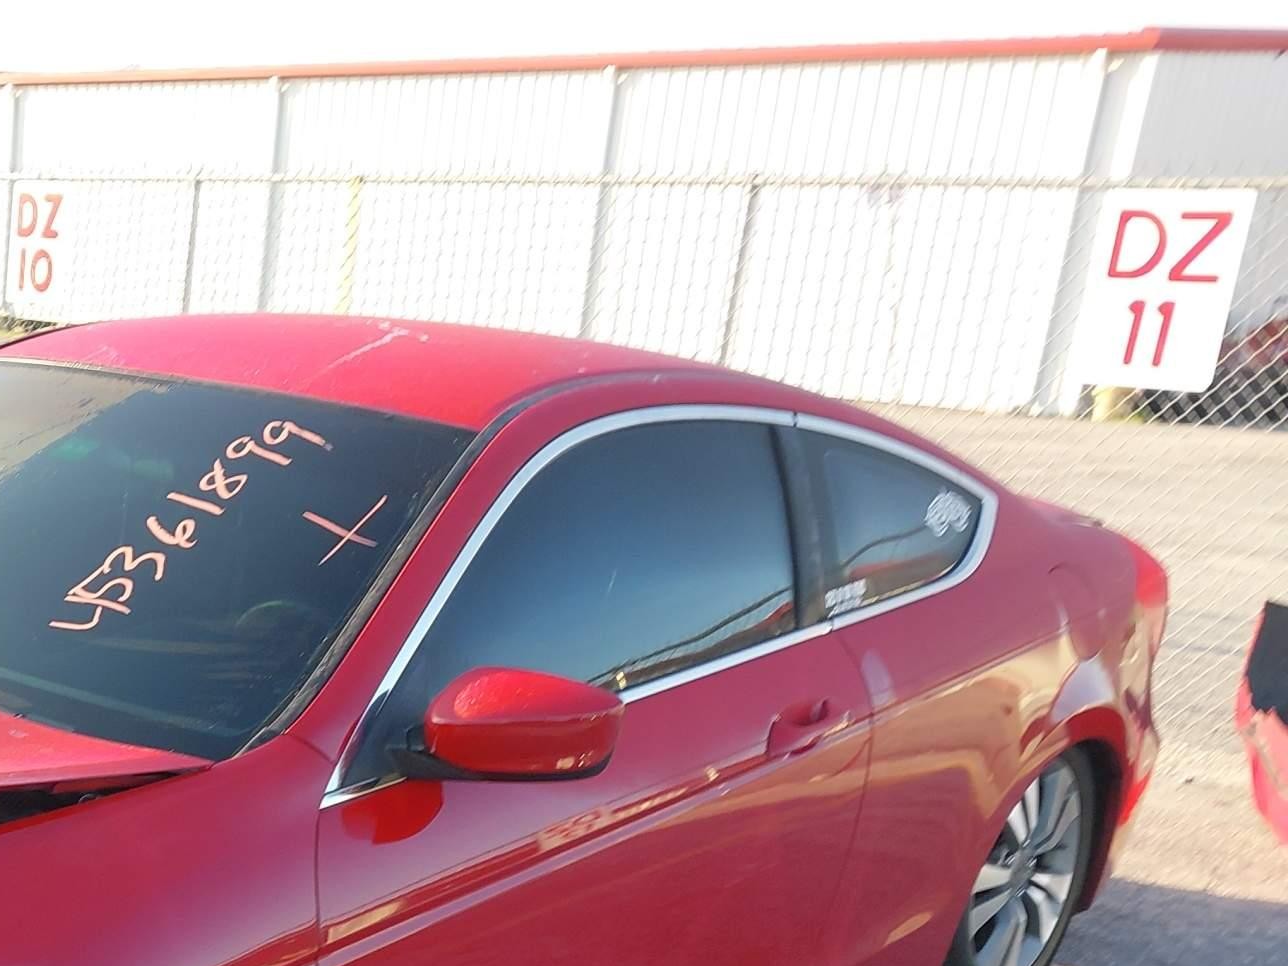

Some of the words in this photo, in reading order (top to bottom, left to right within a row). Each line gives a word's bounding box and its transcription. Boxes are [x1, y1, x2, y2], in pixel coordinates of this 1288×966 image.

[17, 193, 64, 239] DZ
[1107, 209, 1233, 283] DZ
[18, 248, 53, 293] 10
[1123, 299, 1175, 367] 11
[48, 420, 332, 631] 45361899
